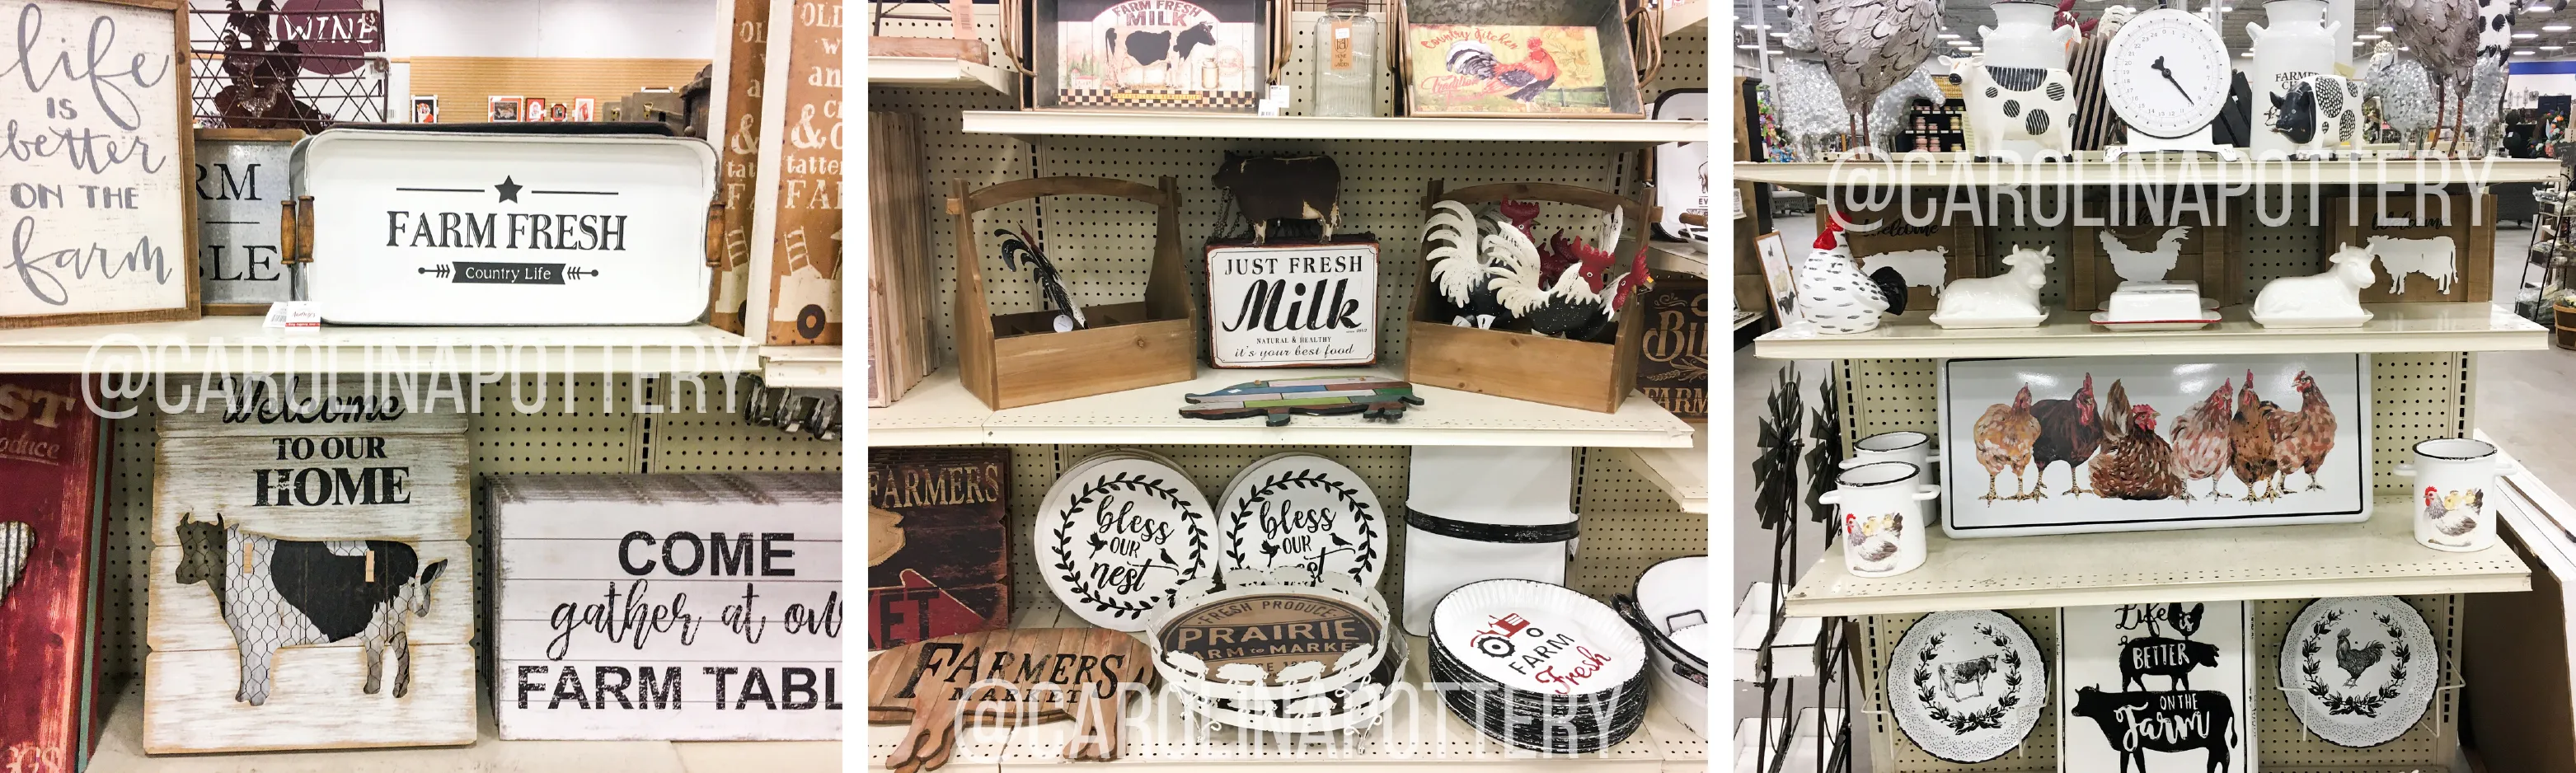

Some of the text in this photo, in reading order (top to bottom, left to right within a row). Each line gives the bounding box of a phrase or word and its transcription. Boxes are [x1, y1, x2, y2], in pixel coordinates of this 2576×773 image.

[1112, 0, 1203, 17] FARM FRESH
[1126, 11, 1188, 26] MILK
[282, 15, 376, 44] WINE
[1421, 27, 1519, 50] Country Kitchen
[0, 3, 169, 130] life
[46, 97, 77, 120] IS
[0, 119, 167, 175] better
[11, 183, 138, 209] ON THE
[386, 211, 627, 251] FARM FRESH
[2, 216, 172, 306] farm
[199, 245, 280, 281] LE
[465, 266, 551, 283] Country Life
[1225, 255, 1363, 275] JUST FRESH
[1222, 278, 1362, 332] Milk
[1235, 344, 1355, 360] it's your best food
[1256, 336, 1289, 344] NATURAL
[1299, 335, 1331, 344] HEALTHY
[218, 375, 406, 424] Welcome
[273, 437, 387, 460] TO OUR
[252, 466, 411, 507] HOME
[868, 463, 999, 508] FARMERS
[1096, 494, 1175, 545] bless
[1260, 500, 1337, 539] bless
[618, 531, 795, 577] COME
[1110, 536, 1141, 559] OUR
[1282, 535, 1311, 554] OUR
[1090, 557, 1180, 593] nest
[547, 579, 701, 661] gather
[721, 583, 766, 645] at
[1200, 600, 1333, 624] FRESH PRODUCE
[2179, 612, 2194, 632] is
[1177, 619, 1360, 649] PRAIRIE
[1269, 640, 1365, 654] MARKE
[1508, 633, 1575, 676] FARM
[2133, 642, 2190, 670] BETTER
[894, 642, 1126, 700] FARMERS
[1535, 645, 1612, 695] Fresh
[518, 665, 682, 710] FARM
[948, 687, 1083, 704] MARKET
[2160, 693, 2198, 711] ON THE
[2114, 701, 2210, 752] Farm
